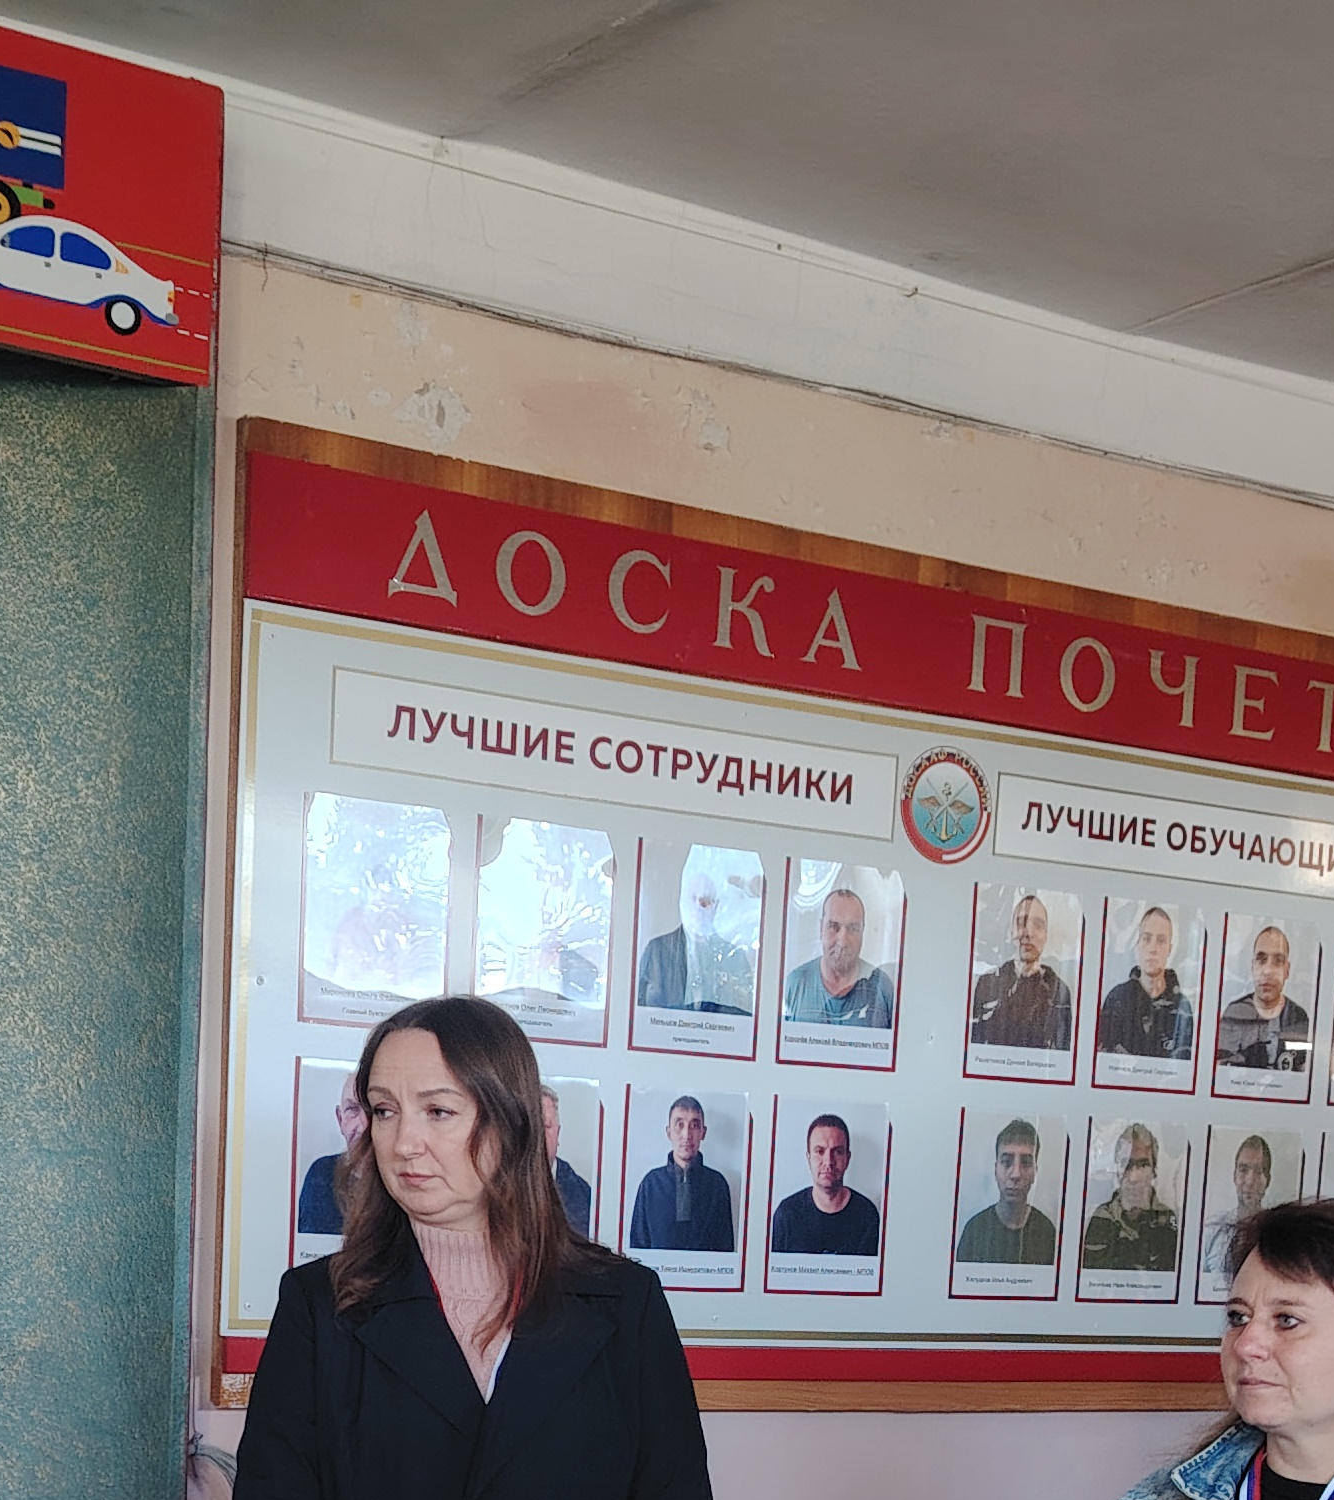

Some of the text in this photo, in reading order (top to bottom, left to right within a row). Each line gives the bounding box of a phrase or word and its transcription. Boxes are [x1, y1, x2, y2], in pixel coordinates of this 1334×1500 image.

[387, 508, 864, 673] ДОСКА
[387, 703, 855, 806] ЛУЧШИЕ СОТРУДНИКИ
[1021, 801, 1157, 850] ЛУЧШИЕ
